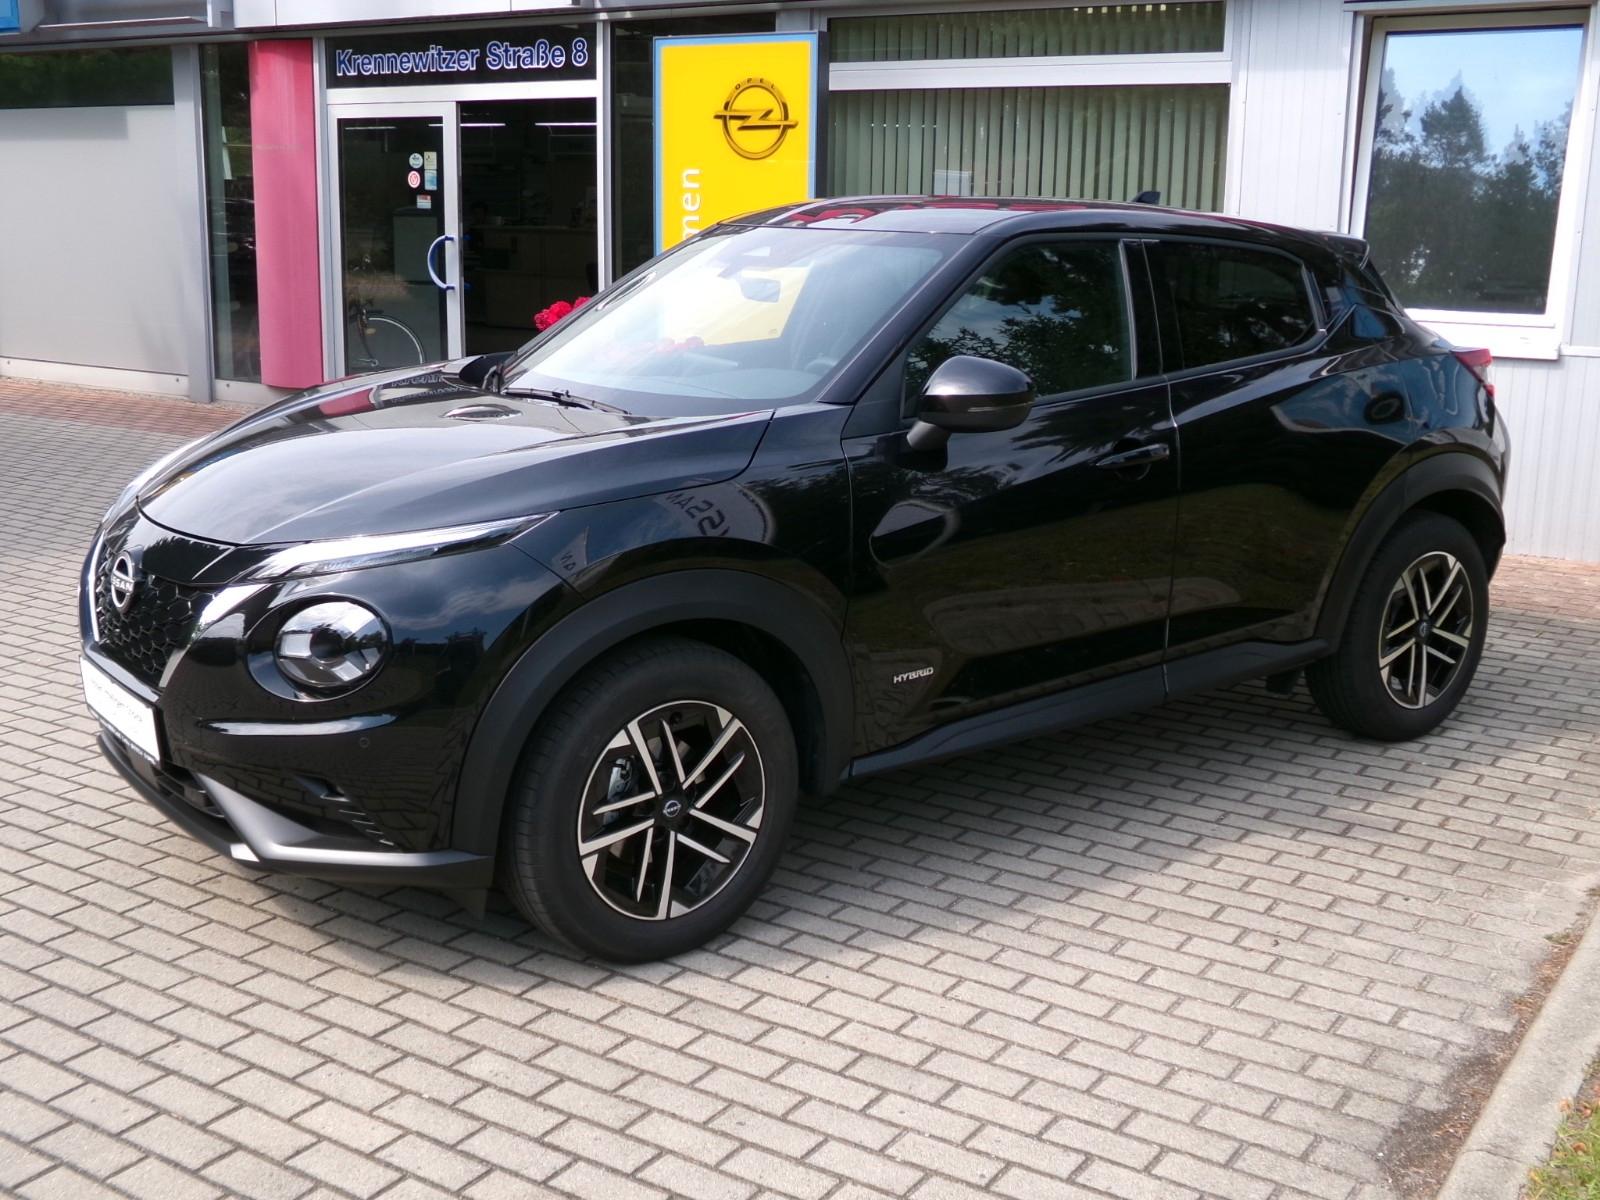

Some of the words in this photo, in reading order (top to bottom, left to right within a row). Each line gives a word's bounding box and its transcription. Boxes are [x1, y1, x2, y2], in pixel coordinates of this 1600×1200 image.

[335, 45, 480, 76] Krennewitzer
[486, 39, 566, 69] Straße
[572, 37, 588, 67] 8
[734, 77, 775, 90] OPEL
[893, 666, 935, 684] HYBRID
